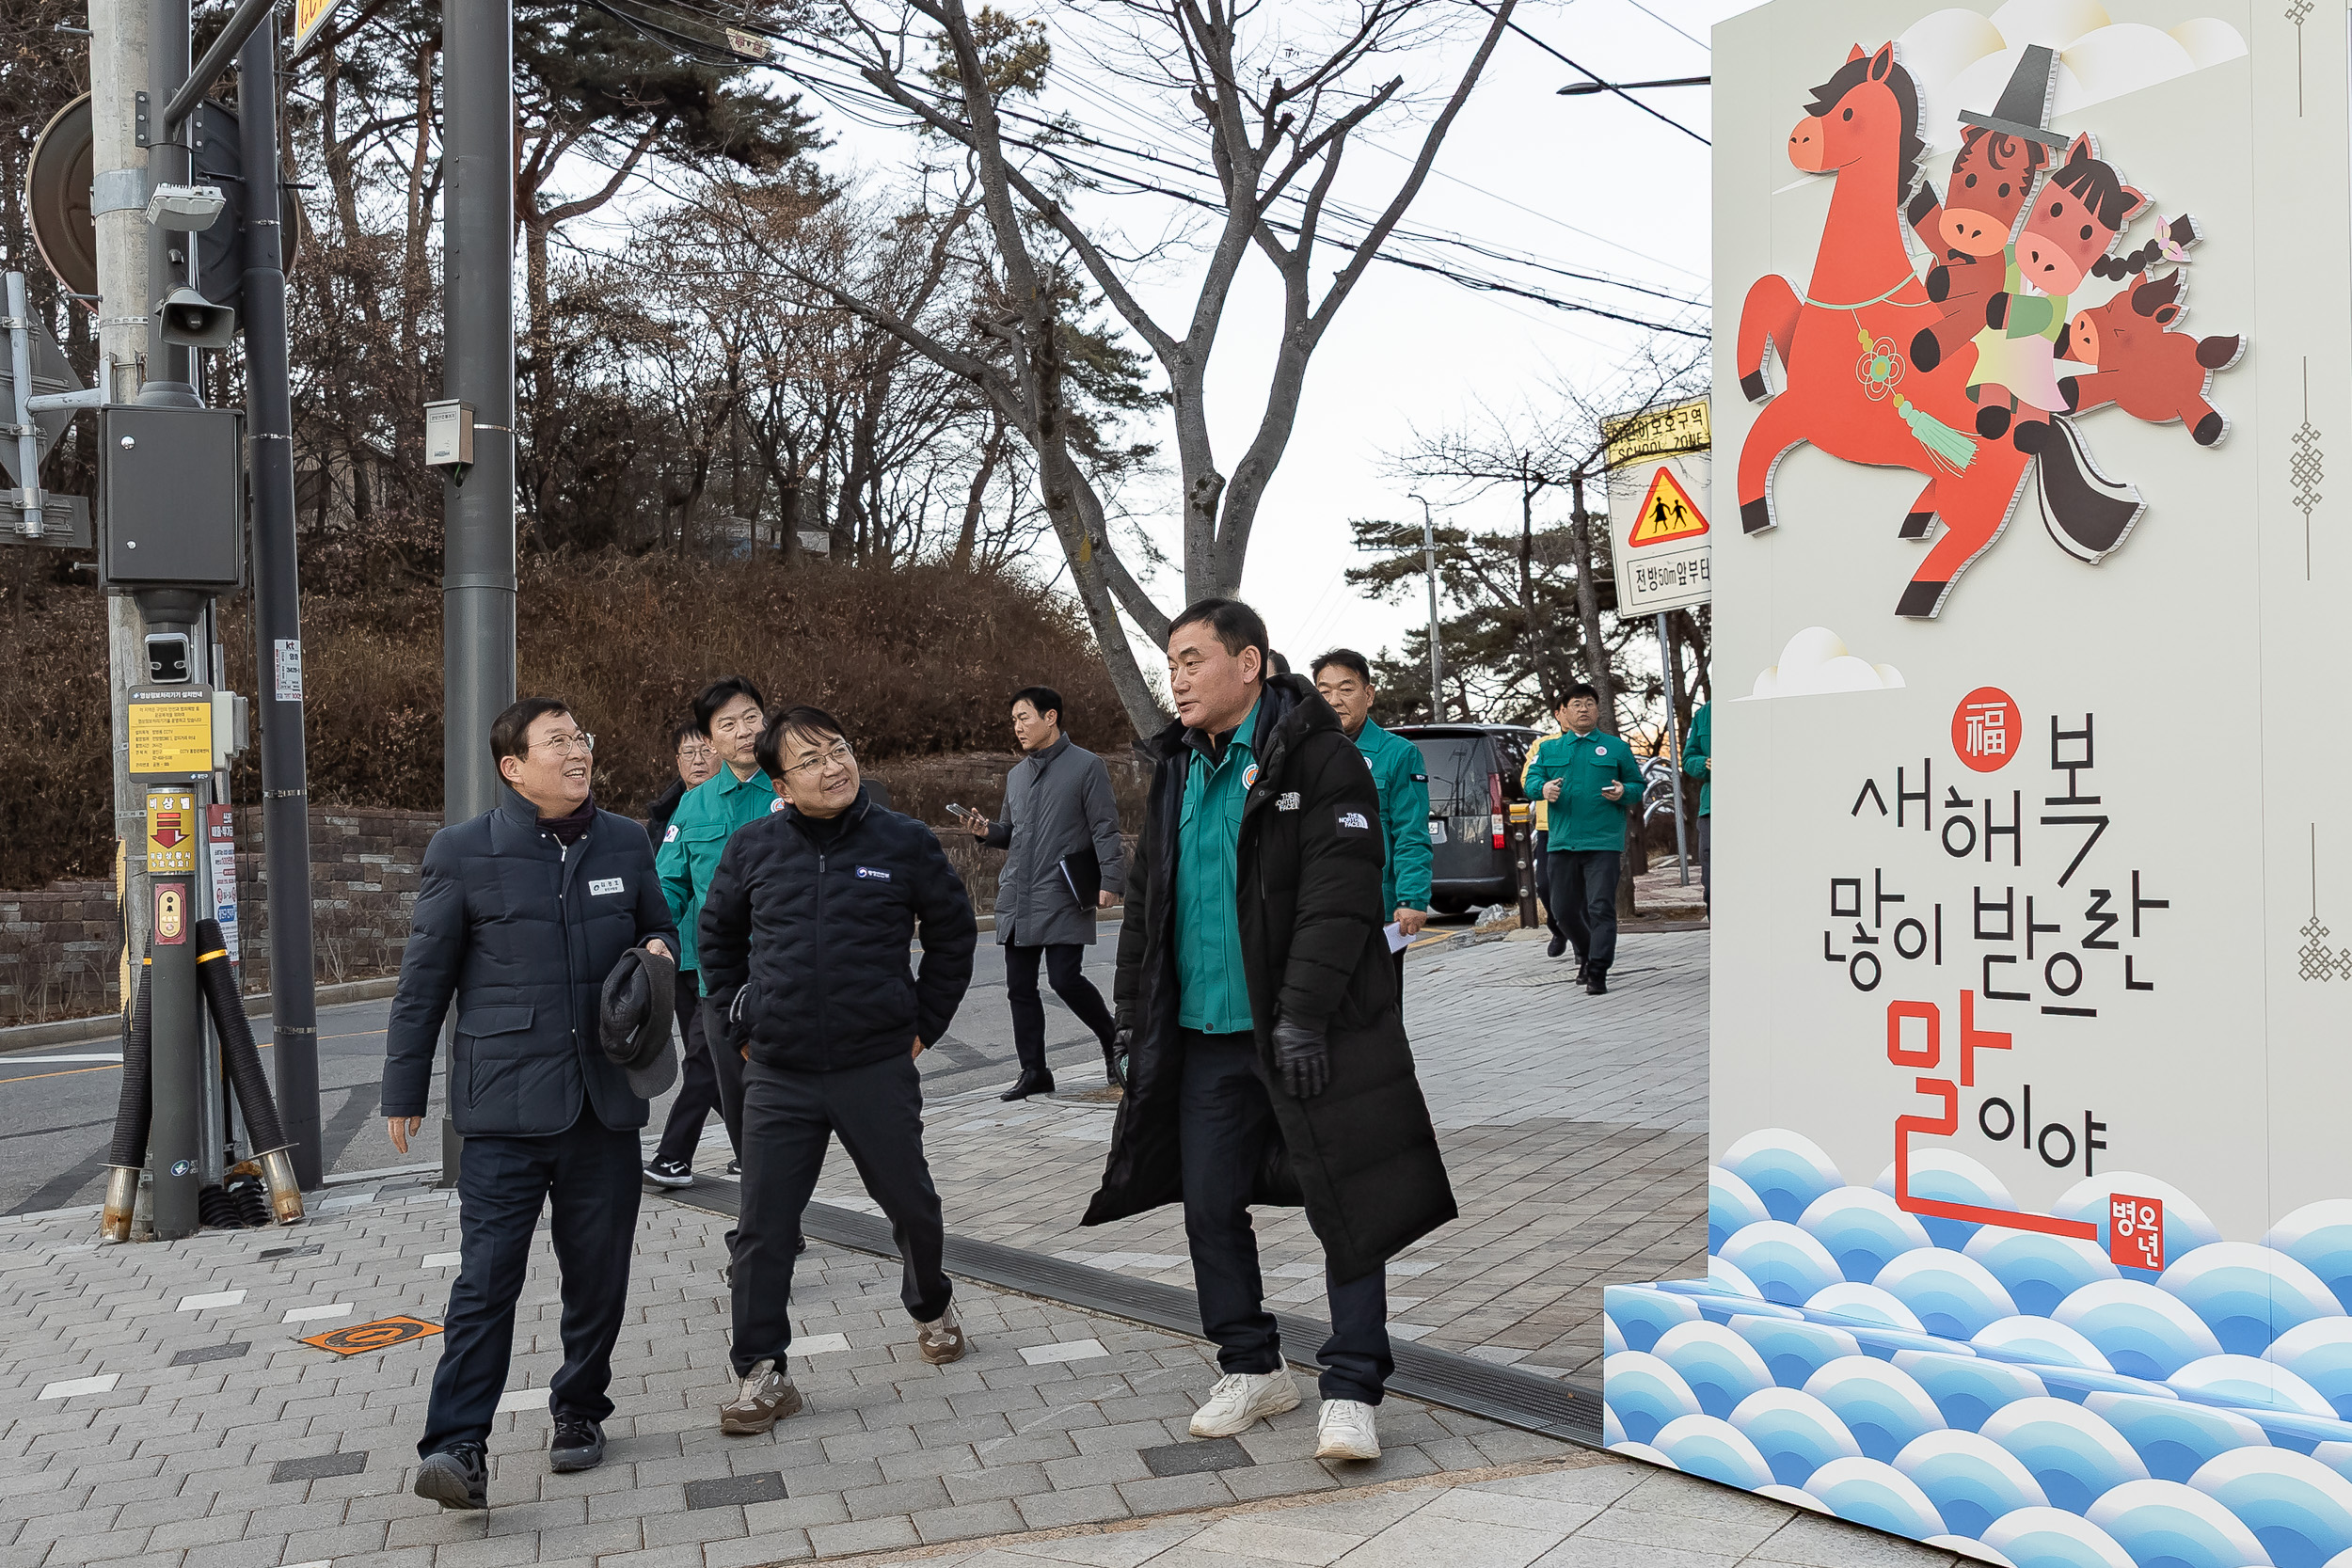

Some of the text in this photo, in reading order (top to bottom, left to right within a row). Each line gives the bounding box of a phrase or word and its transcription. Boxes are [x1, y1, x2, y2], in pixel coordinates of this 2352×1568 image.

[286, 641, 294, 650] kt
[139, 690, 203, 700] 영상정보처리기기 설치안내
[1965, 702, 2008, 757] 福
[149, 797, 190, 810] 비상벨
[1279, 803, 1295, 812] FACE
[1851, 713, 2110, 888] 새해 복
[1824, 868, 2170, 1018] 많이 받으란
[2112, 1200, 2159, 1268] 병오년
